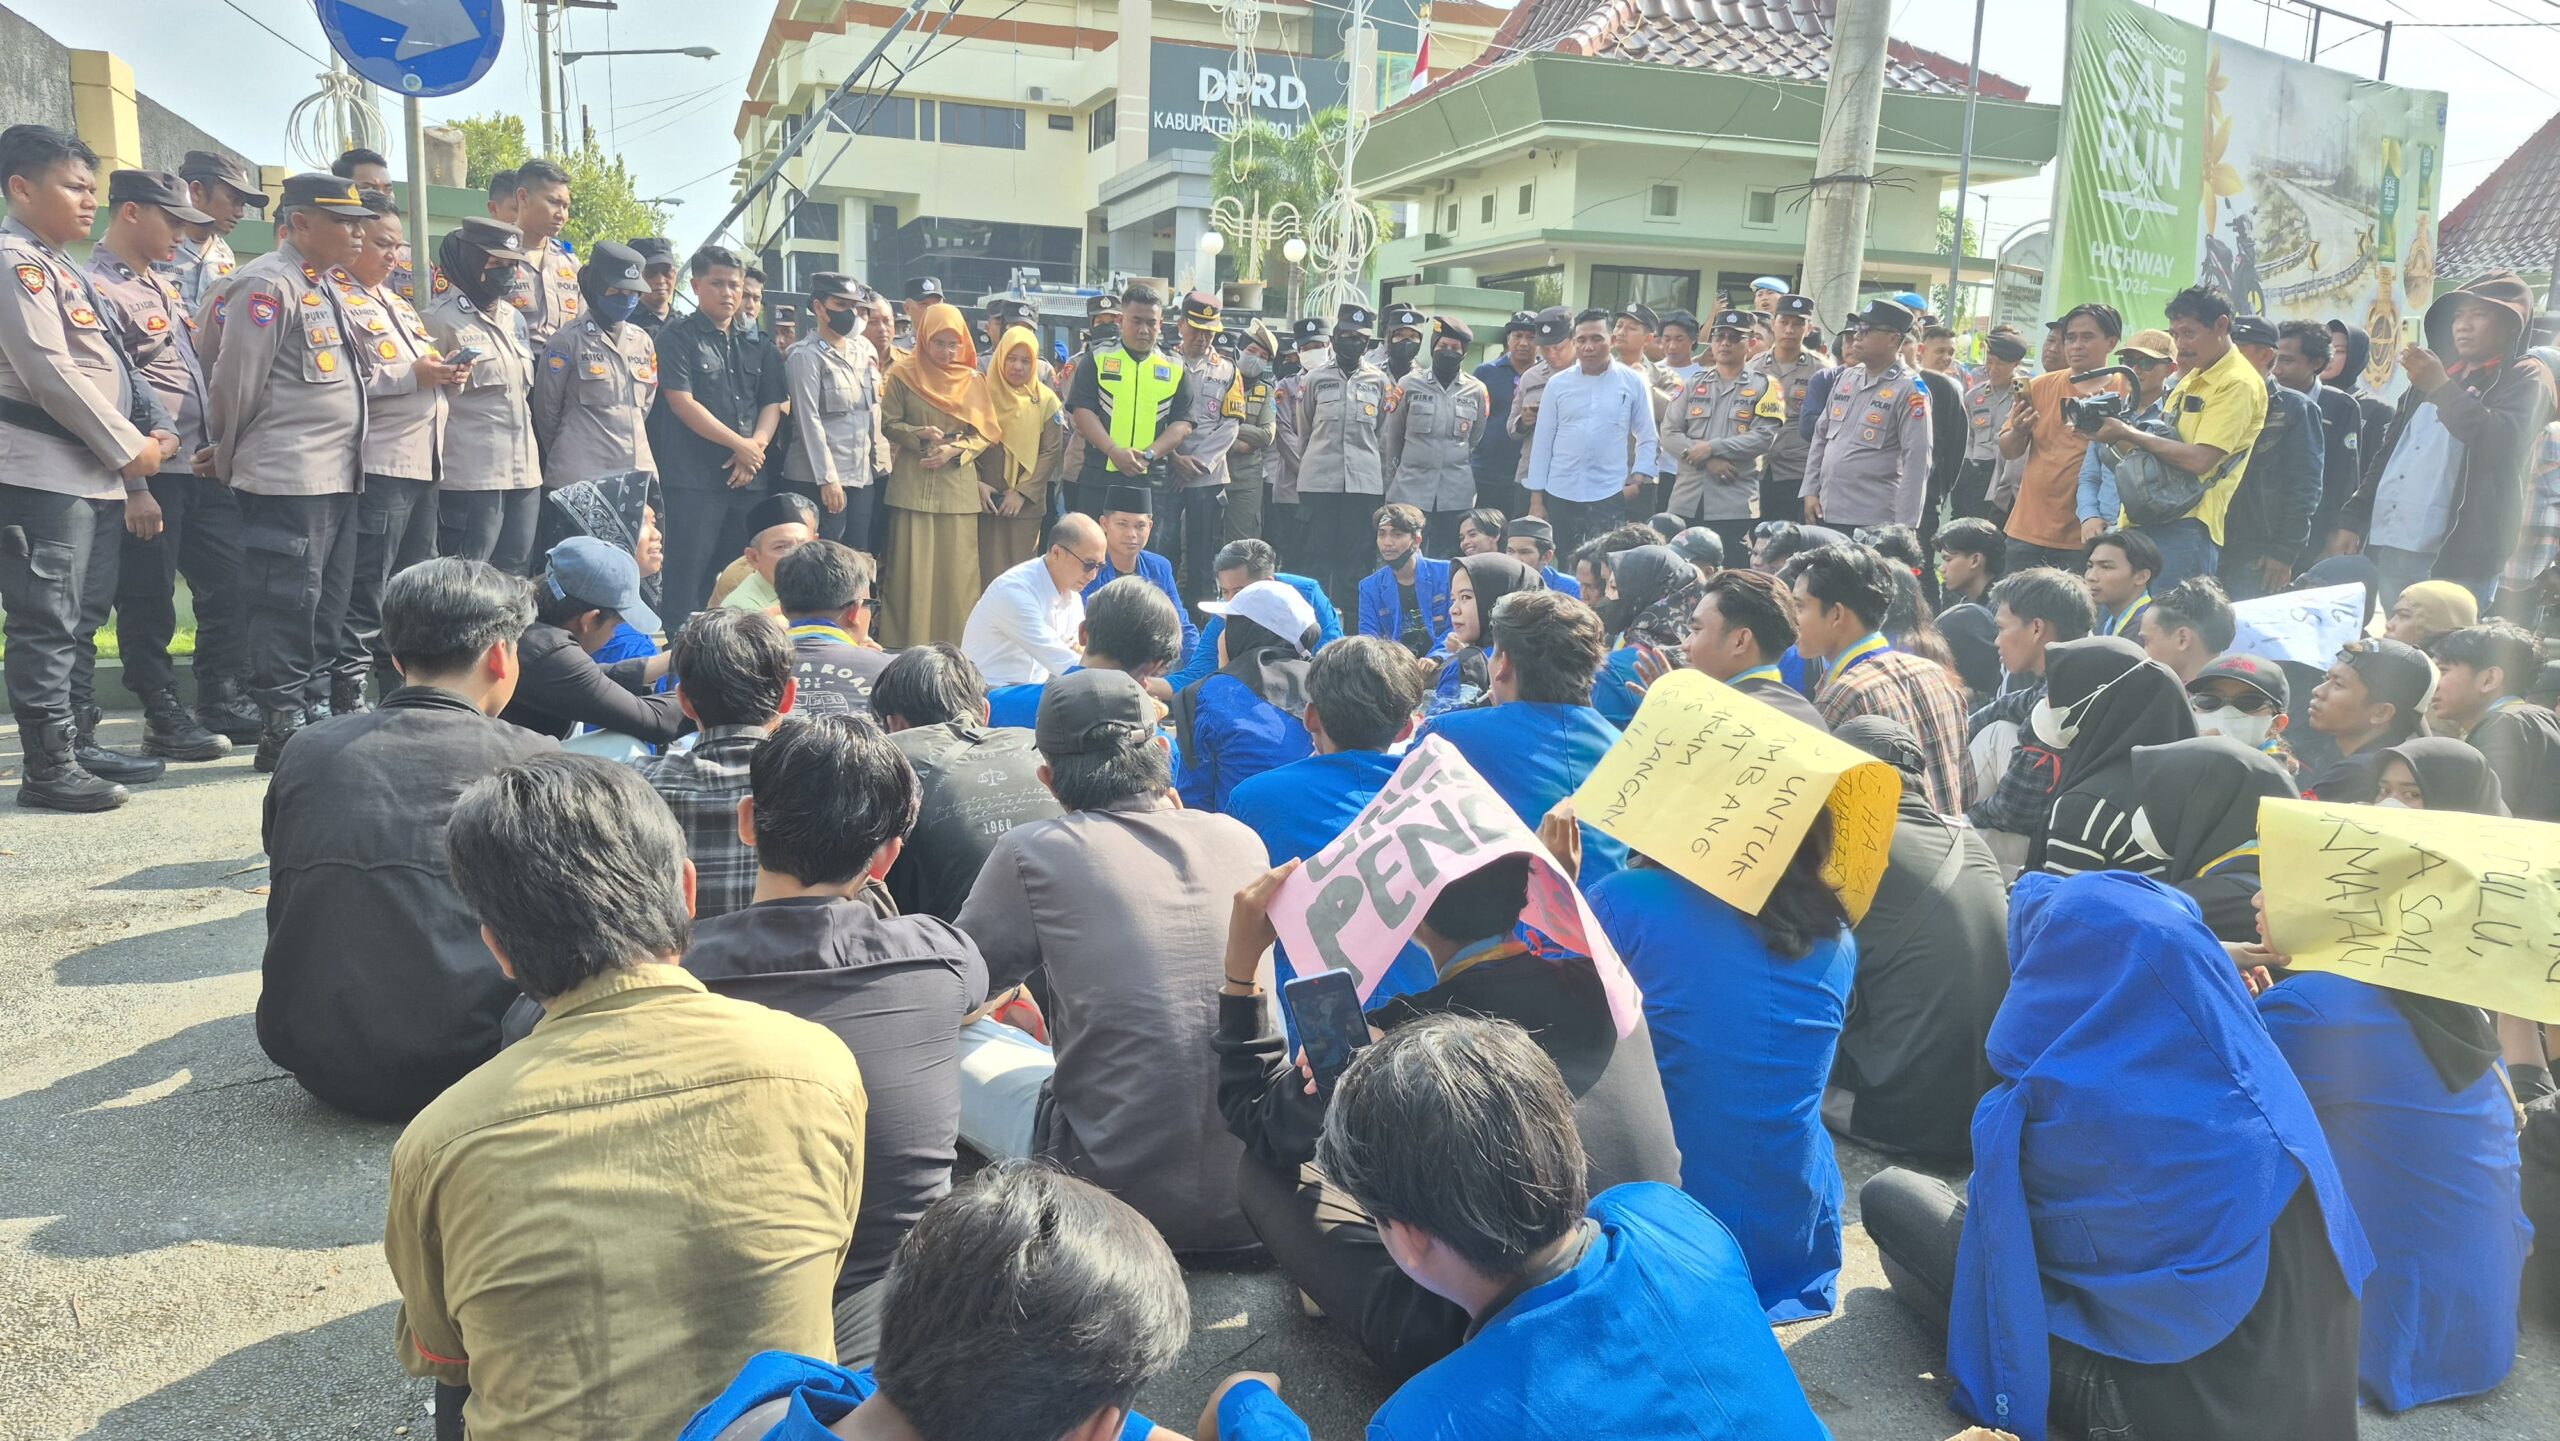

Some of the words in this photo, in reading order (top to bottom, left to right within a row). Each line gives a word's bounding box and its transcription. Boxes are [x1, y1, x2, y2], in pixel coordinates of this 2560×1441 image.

[1198, 66, 1307, 110] DPRD
[2105, 50, 2185, 130] SAE
[2098, 115, 2184, 191] RUN
[2090, 240, 2175, 279] HIGHWAY
[2115, 277, 2149, 295] 2026
[1869, 399, 1891, 411] POLRI
[1600, 728, 1677, 829] JANGAN
[984, 818, 1012, 835] 1960
[1728, 775, 1806, 881] UNTUK
[2381, 892, 2443, 968] SOAL
